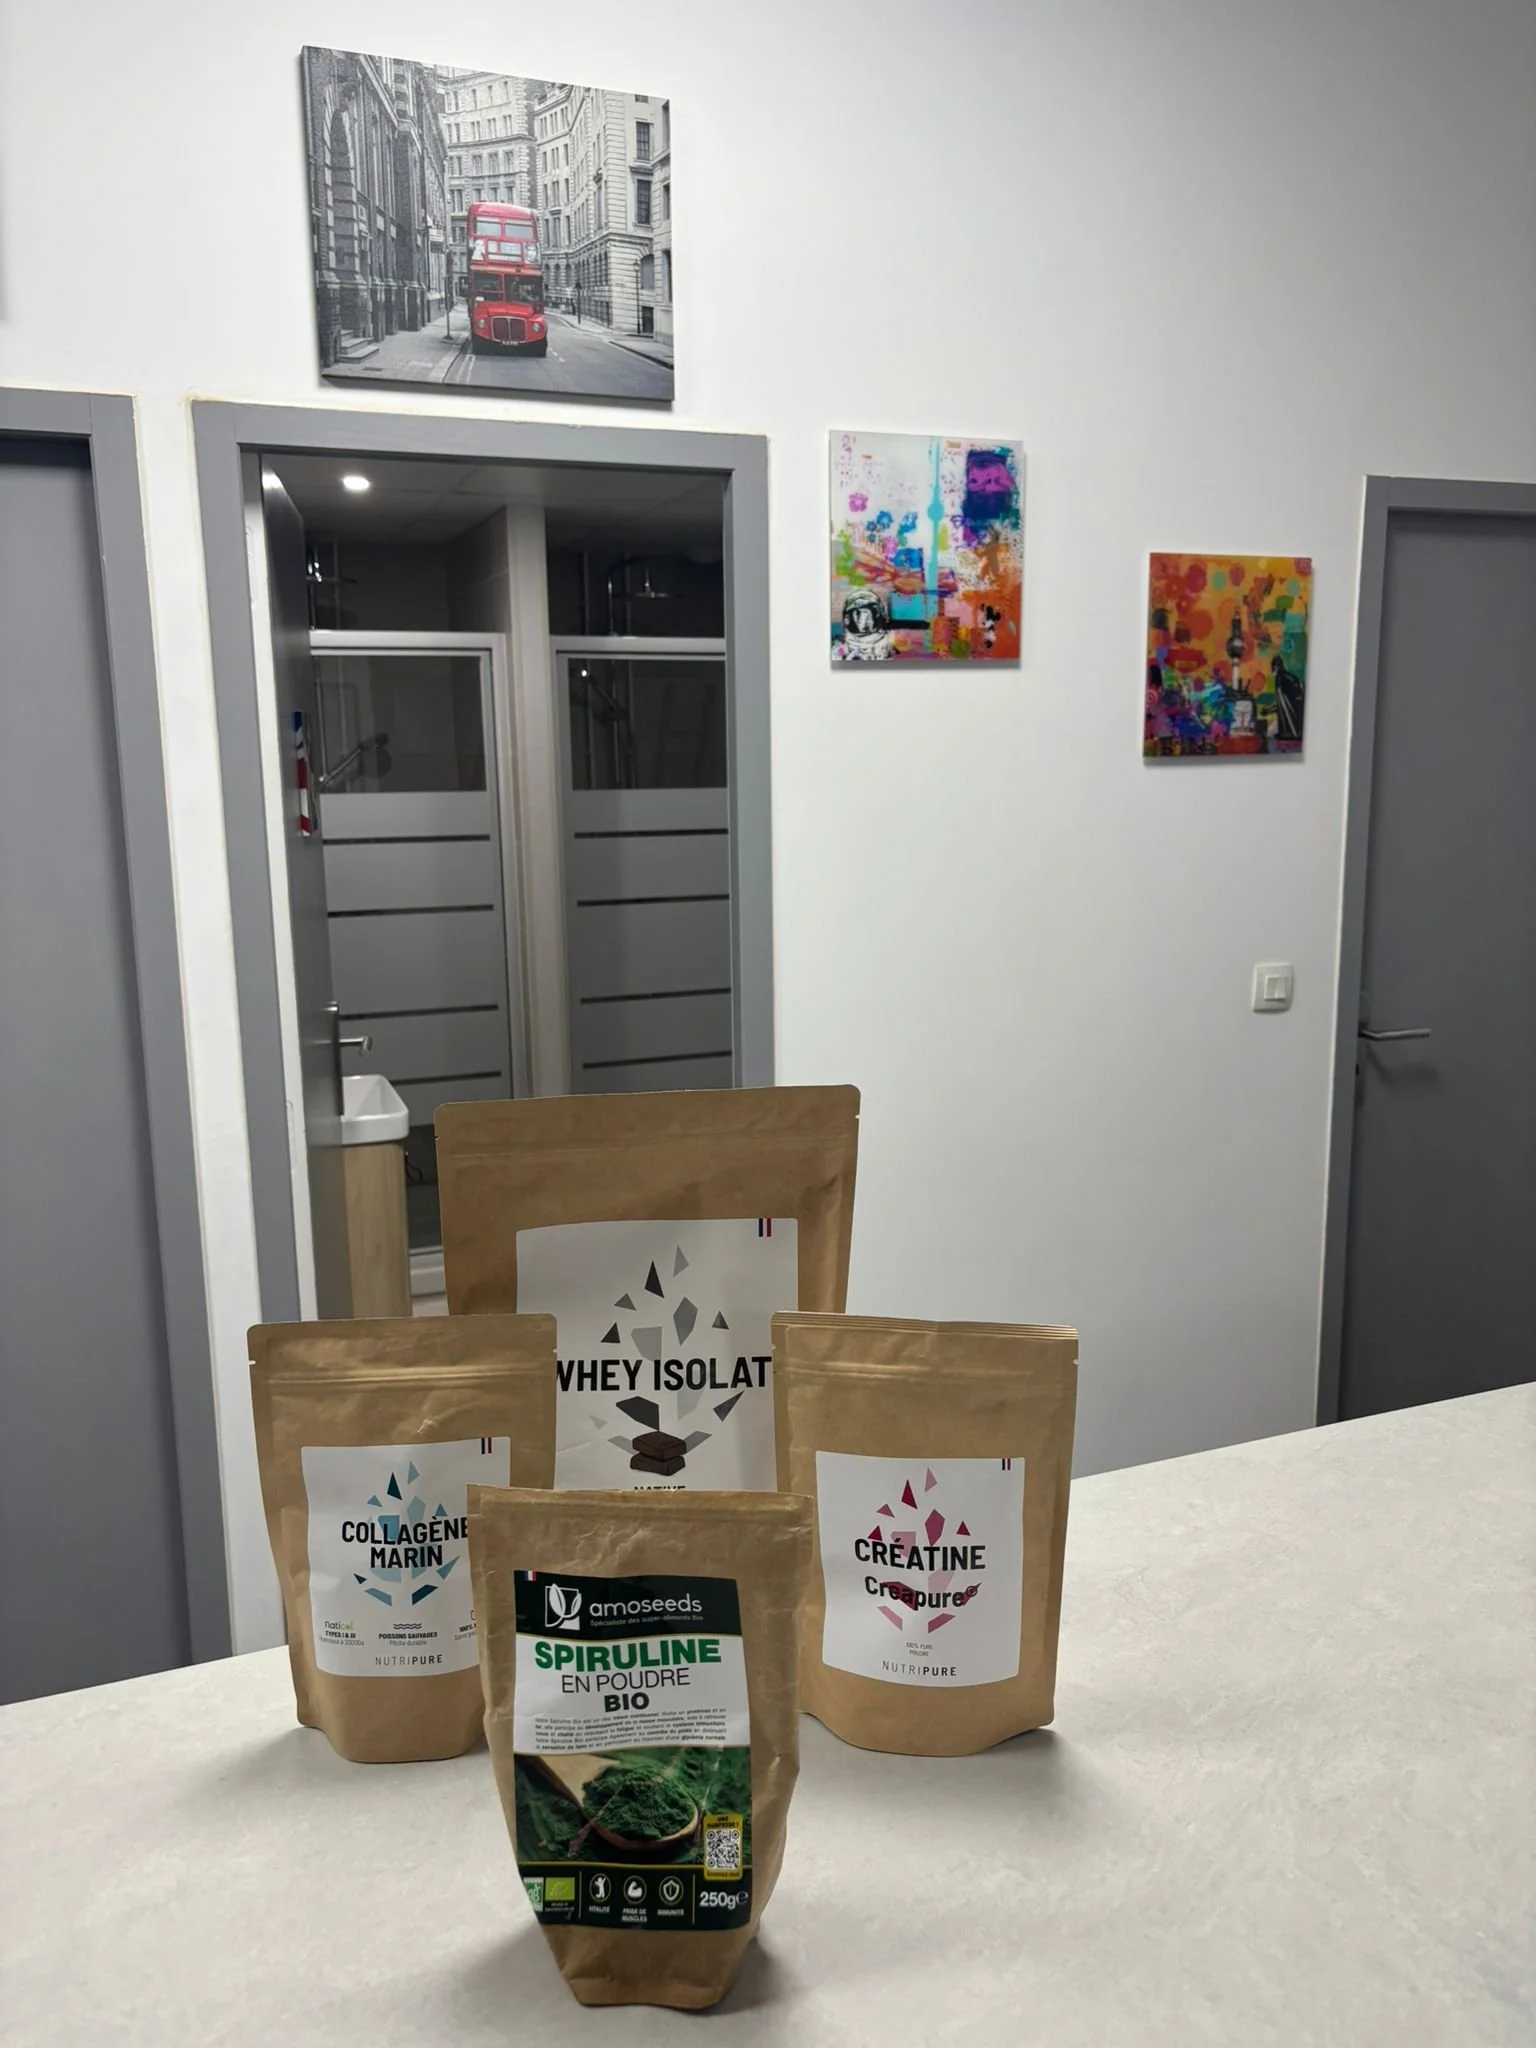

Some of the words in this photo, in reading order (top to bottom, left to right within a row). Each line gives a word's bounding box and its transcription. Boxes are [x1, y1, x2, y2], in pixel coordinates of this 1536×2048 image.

[557, 1359, 643, 1392] WHEY
[654, 1356, 772, 1390] ISOLAT
[370, 1545, 443, 1569] MARIN
[854, 1538, 986, 1572] CRÉATINE
[589, 1593, 703, 1618] amoseeds
[375, 1654, 443, 1666] NUTRIPURE
[535, 1638, 722, 1673] SPIRULINE
[561, 1674, 591, 1694] EN
[597, 1667, 690, 1692] POUDRE
[882, 1660, 957, 1677] NUTRIPURE
[604, 1692, 650, 1713] BIO
